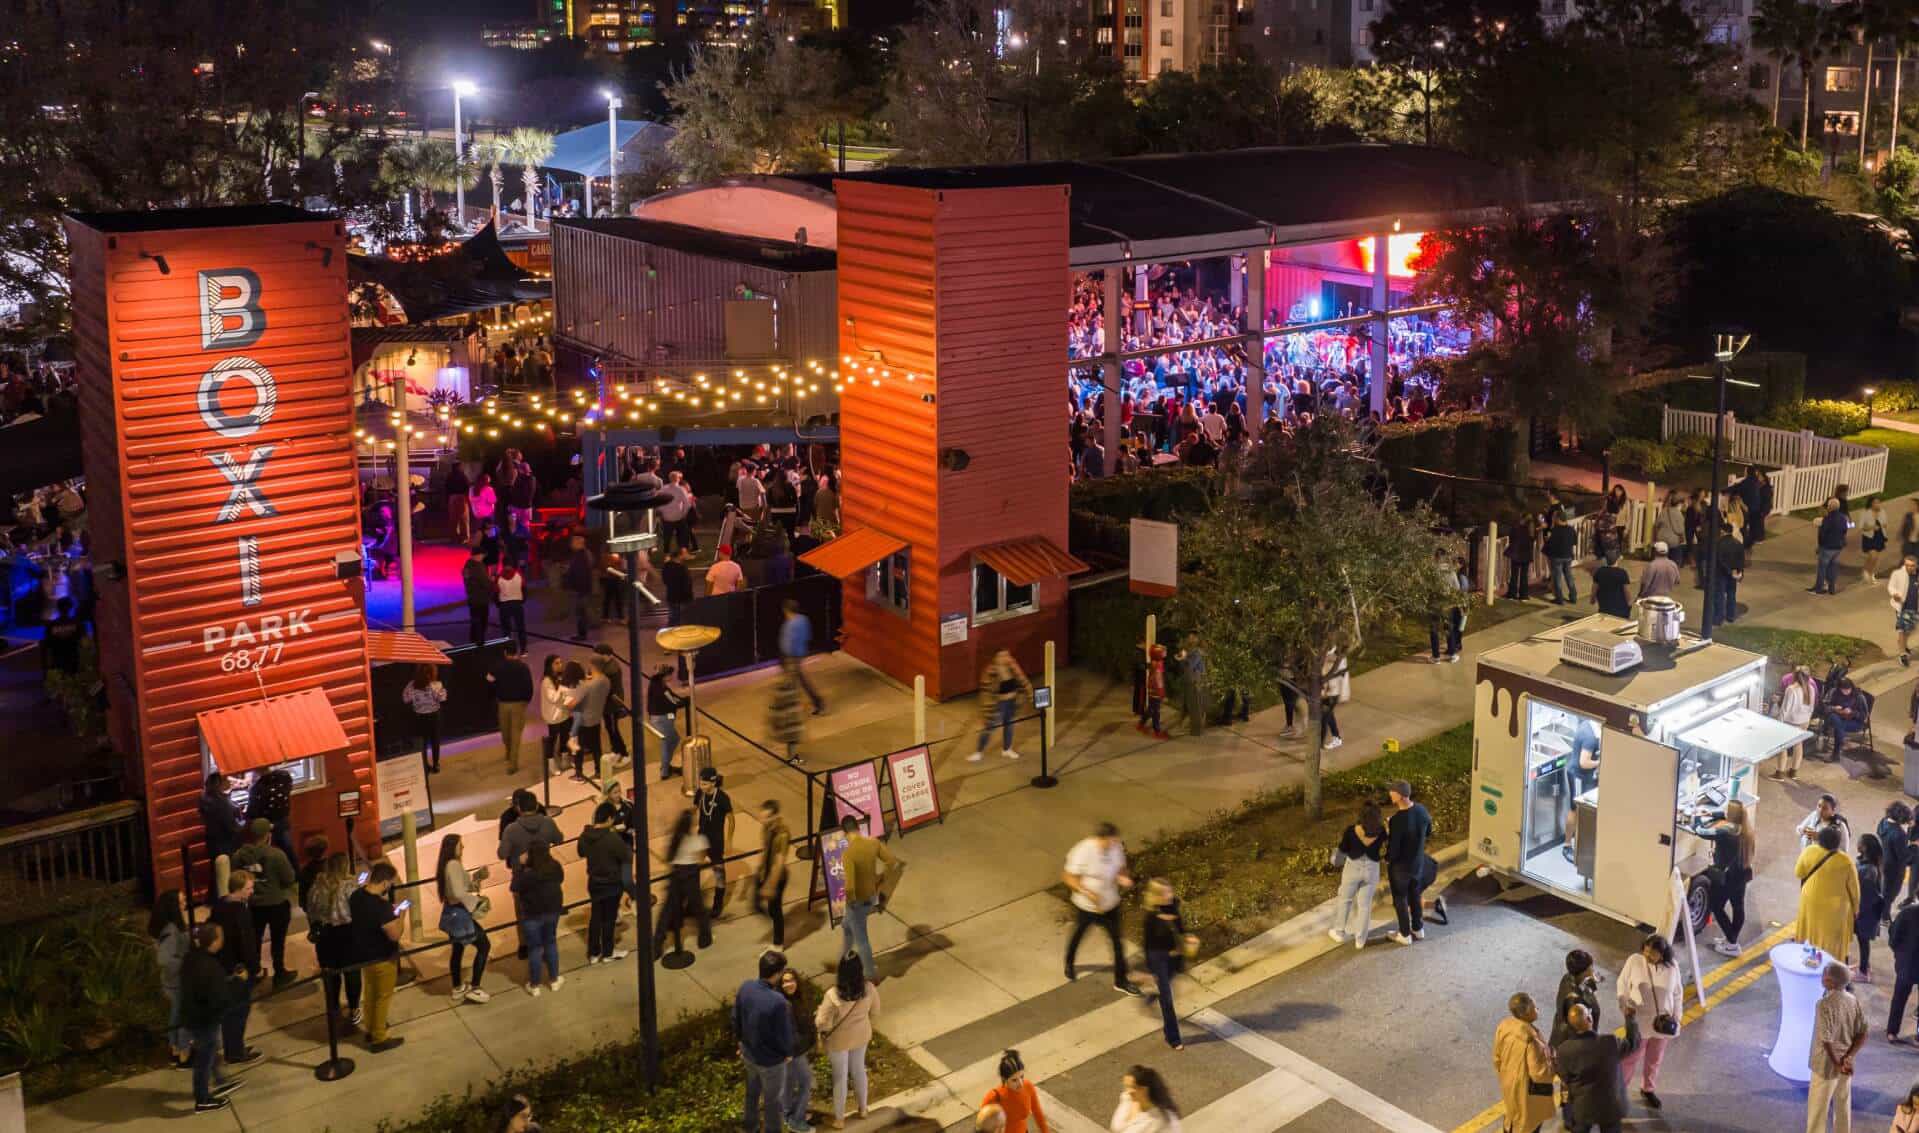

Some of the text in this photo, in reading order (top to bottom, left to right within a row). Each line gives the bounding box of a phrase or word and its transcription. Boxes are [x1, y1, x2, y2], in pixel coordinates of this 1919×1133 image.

[197, 267, 278, 607] BOXI
[203, 609, 312, 652] PARK
[903, 780, 926, 793] COVER
